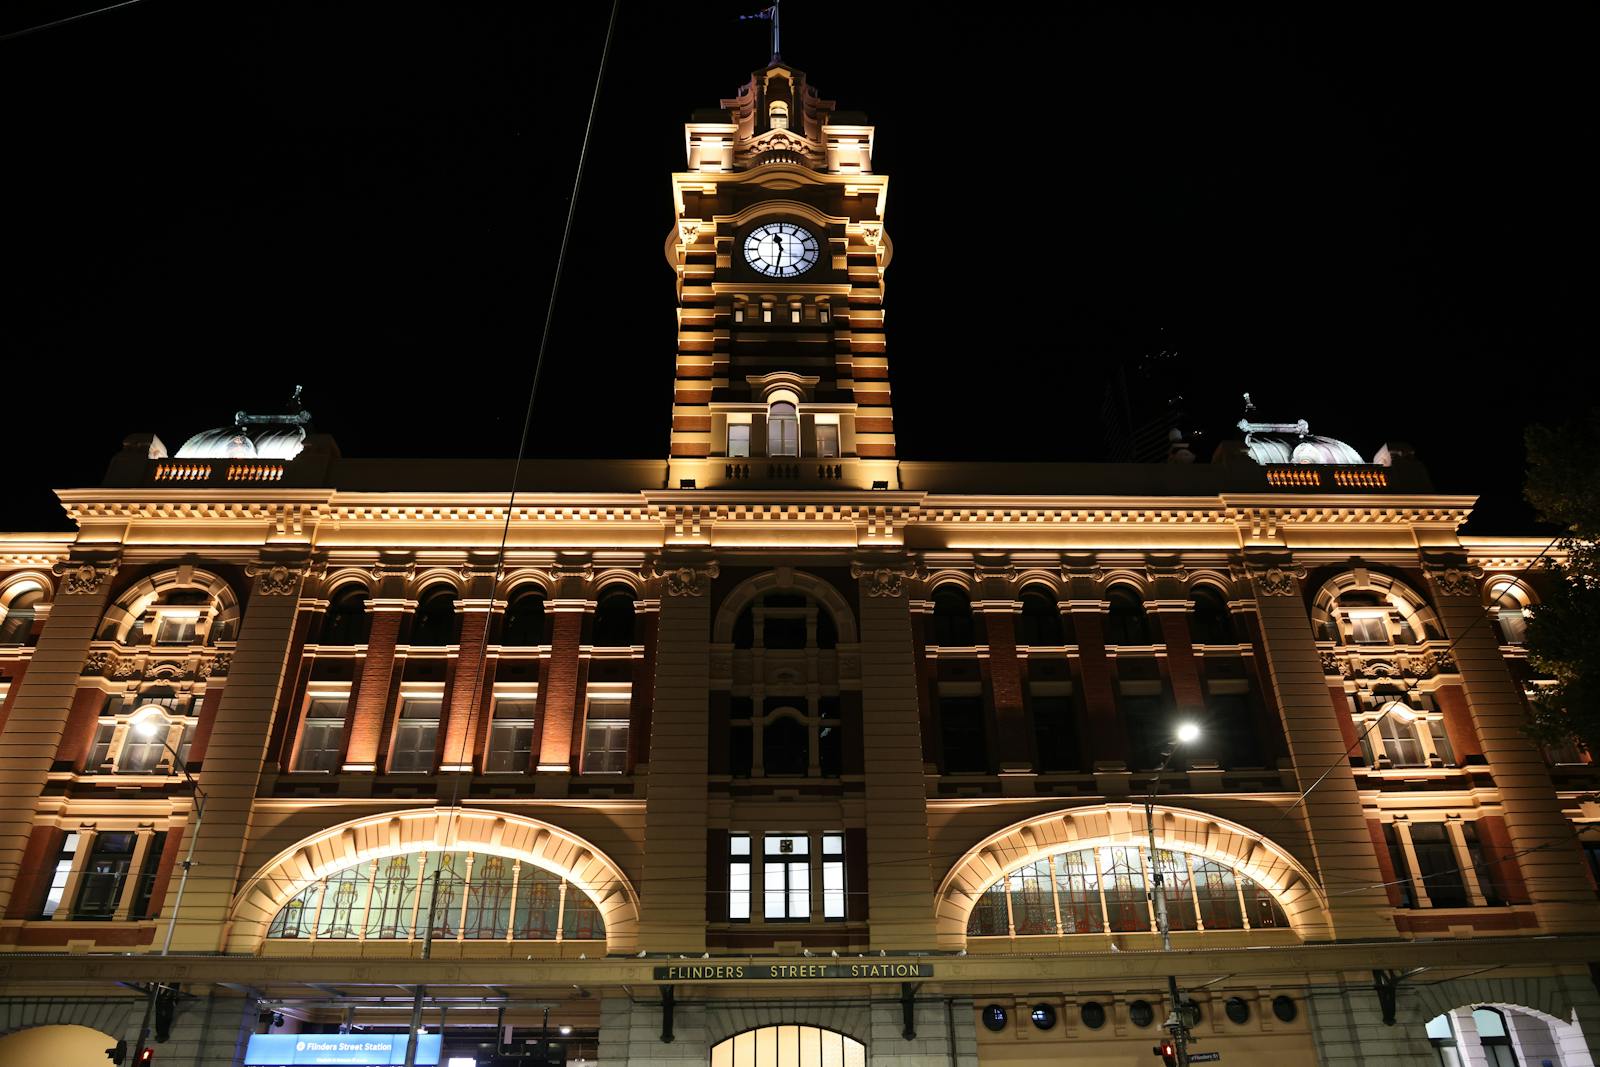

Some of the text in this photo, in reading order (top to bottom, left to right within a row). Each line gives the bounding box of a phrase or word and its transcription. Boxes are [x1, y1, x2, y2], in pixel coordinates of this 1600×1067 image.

[669, 964, 920, 979] FLINDERS STREET STATION
[307, 1042, 392, 1051] Flinders Street Station
